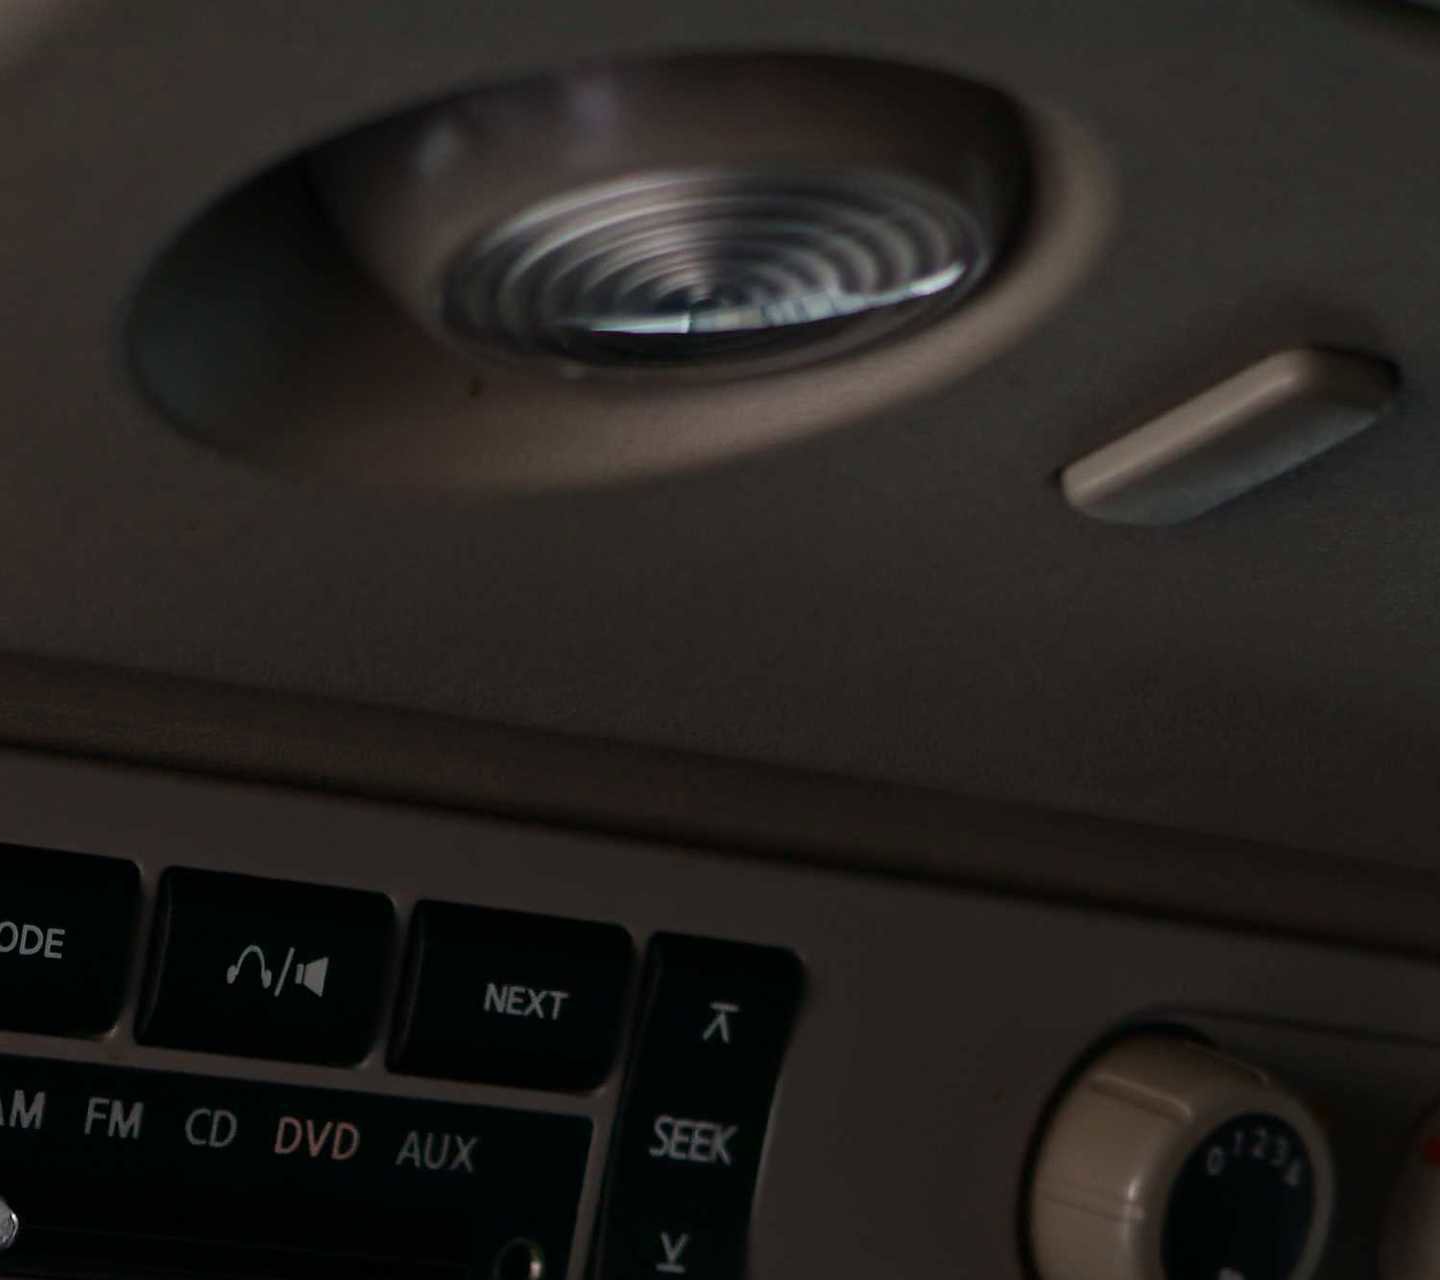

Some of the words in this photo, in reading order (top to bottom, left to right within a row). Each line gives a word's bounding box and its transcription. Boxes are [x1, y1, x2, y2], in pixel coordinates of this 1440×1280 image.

[483, 982, 570, 1021] NEXT
[83, 1096, 144, 1140] FM
[184, 1107, 238, 1149] CD
[274, 1115, 361, 1162] DVD
[396, 1130, 480, 1173] AUX
[649, 1114, 740, 1165] SEEK
